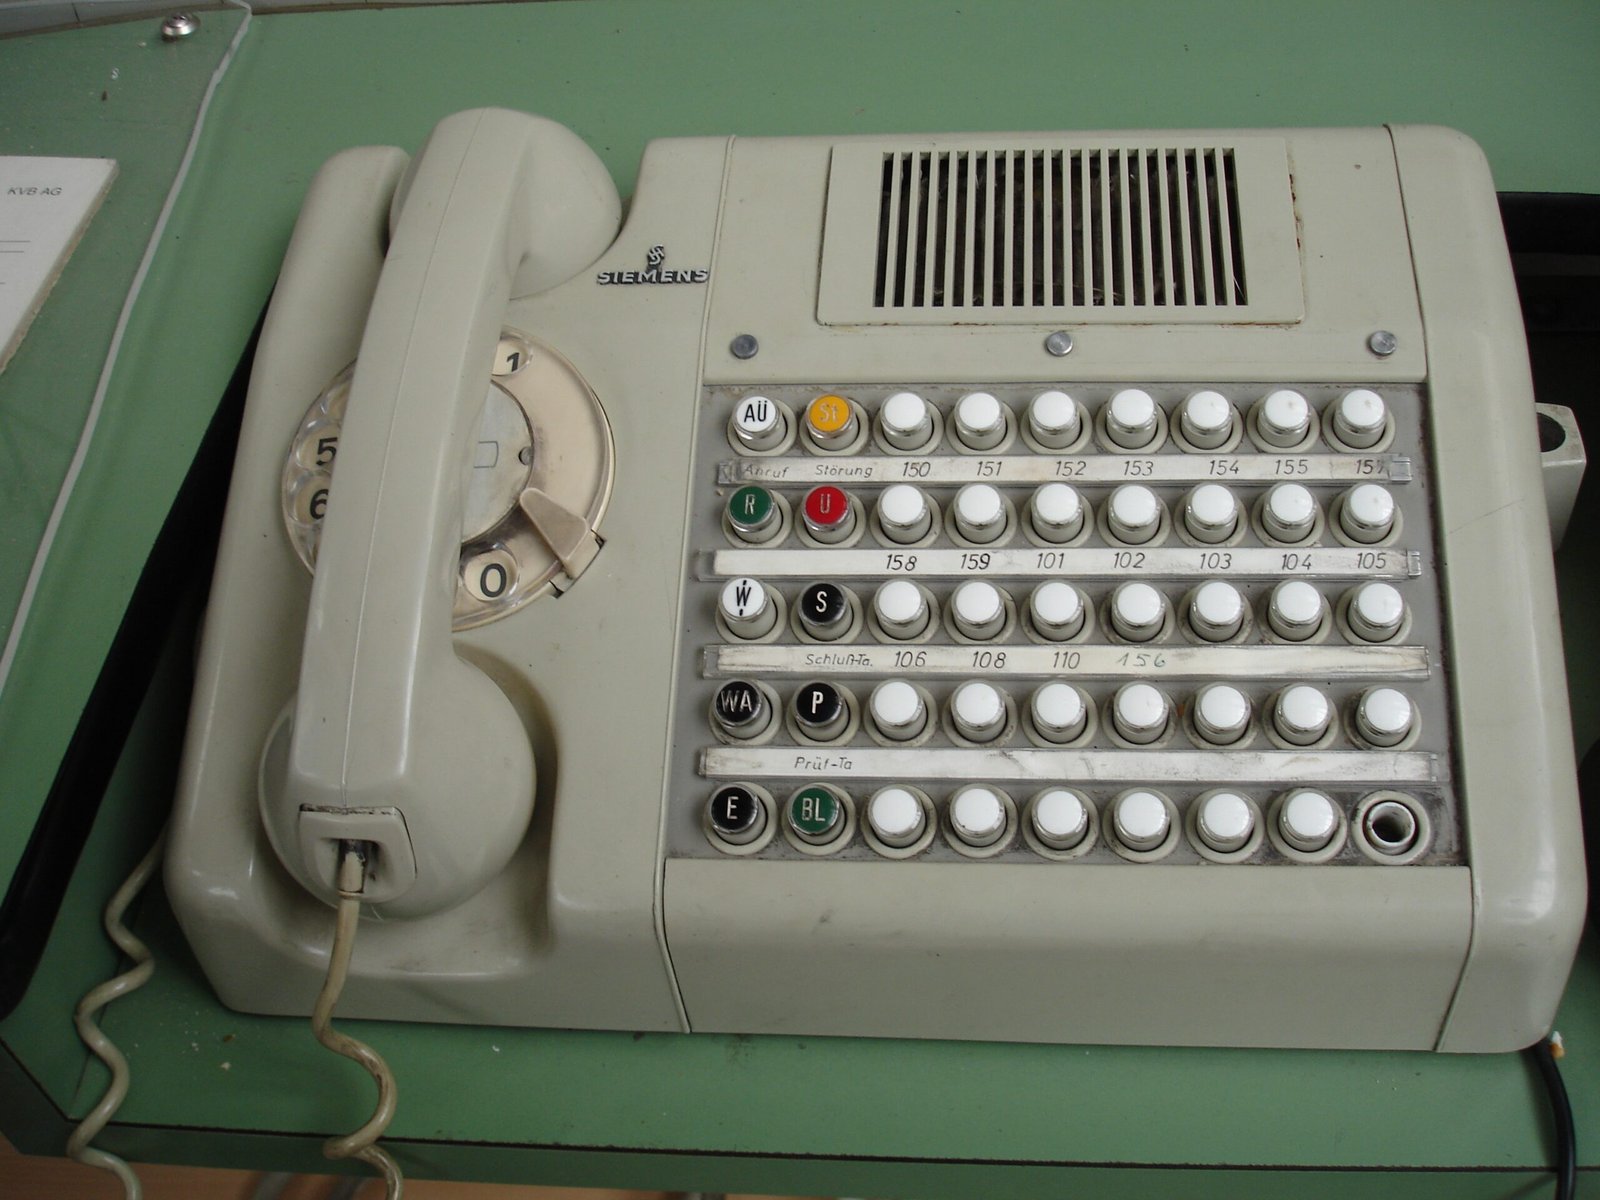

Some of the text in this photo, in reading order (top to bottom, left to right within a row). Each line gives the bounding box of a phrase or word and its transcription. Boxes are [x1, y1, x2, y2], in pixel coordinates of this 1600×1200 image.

[7, 187, 63, 196] KVB AG
[597, 269, 709, 285] SIEMENS
[506, 352, 520, 373] 1
[744, 400, 768, 422] AÜ
[819, 403, 840, 422] St
[316, 436, 338, 466] 5
[743, 464, 790, 479] Anruf
[815, 465, 874, 478] Störung
[902, 461, 931, 478] 150
[976, 460, 1003, 477] 151
[1055, 461, 1087, 476] 152
[1124, 461, 1154, 477] 153
[1209, 459, 1240, 475] 154
[1275, 459, 1309, 475] 155
[309, 489, 329, 520] 6
[744, 494, 756, 515] R
[886, 552, 1387, 572] 158 159 101 102 103 104 105
[815, 591, 828, 613] S
[895, 650, 927, 668] 106
[972, 651, 1006, 669] 108
[1053, 651, 1081, 670] 110
[1118, 653, 1166, 668] 156
[720, 689, 753, 713] WA
[811, 691, 824, 715] P
[726, 796, 739, 820] E
[802, 797, 826, 822] BL
